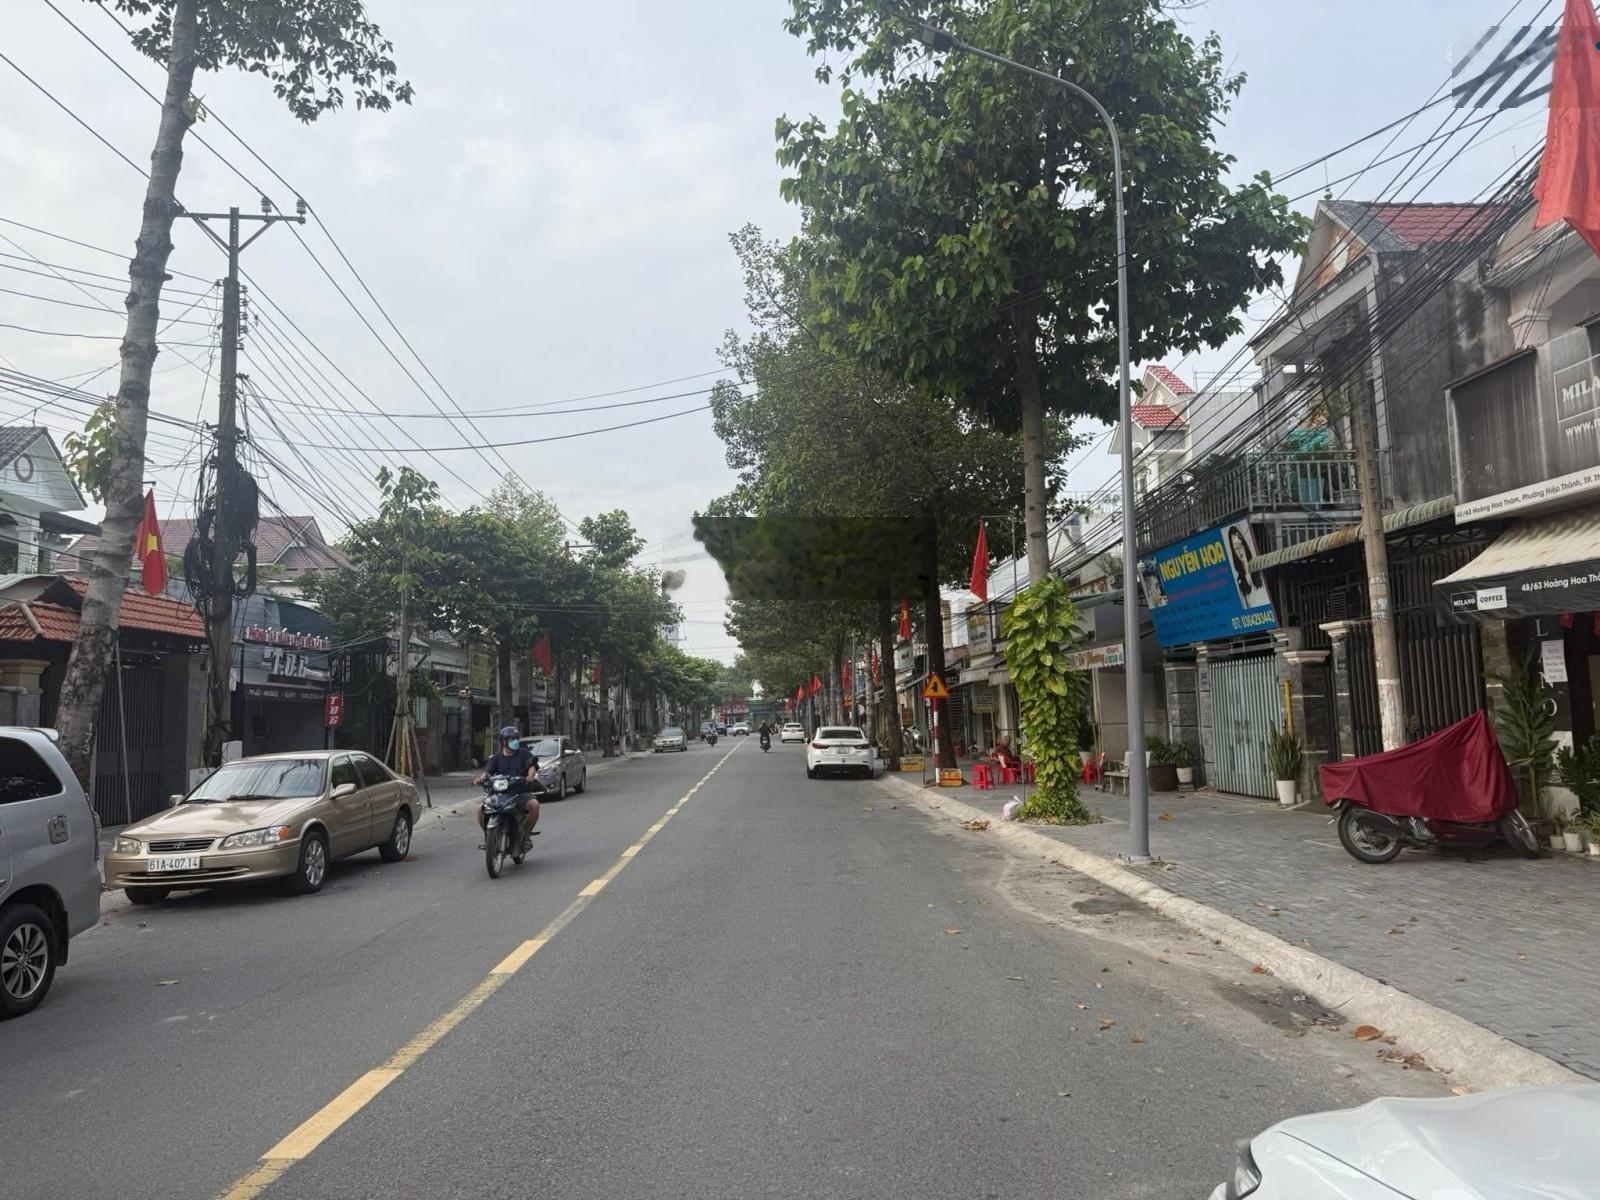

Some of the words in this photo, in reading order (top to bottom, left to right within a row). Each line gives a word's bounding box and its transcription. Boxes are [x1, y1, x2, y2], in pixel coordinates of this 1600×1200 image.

[1159, 546, 1200, 581] NGUYỄN
[1200, 541, 1226, 567] HOA
[1521, 581, 1542, 592] 48/63
[1543, 577, 1569, 589] Hoàng
[1570, 575, 1587, 586] Hoa
[1453, 598, 1476, 607] MILANO
[1479, 594, 1504, 603] COFFEE
